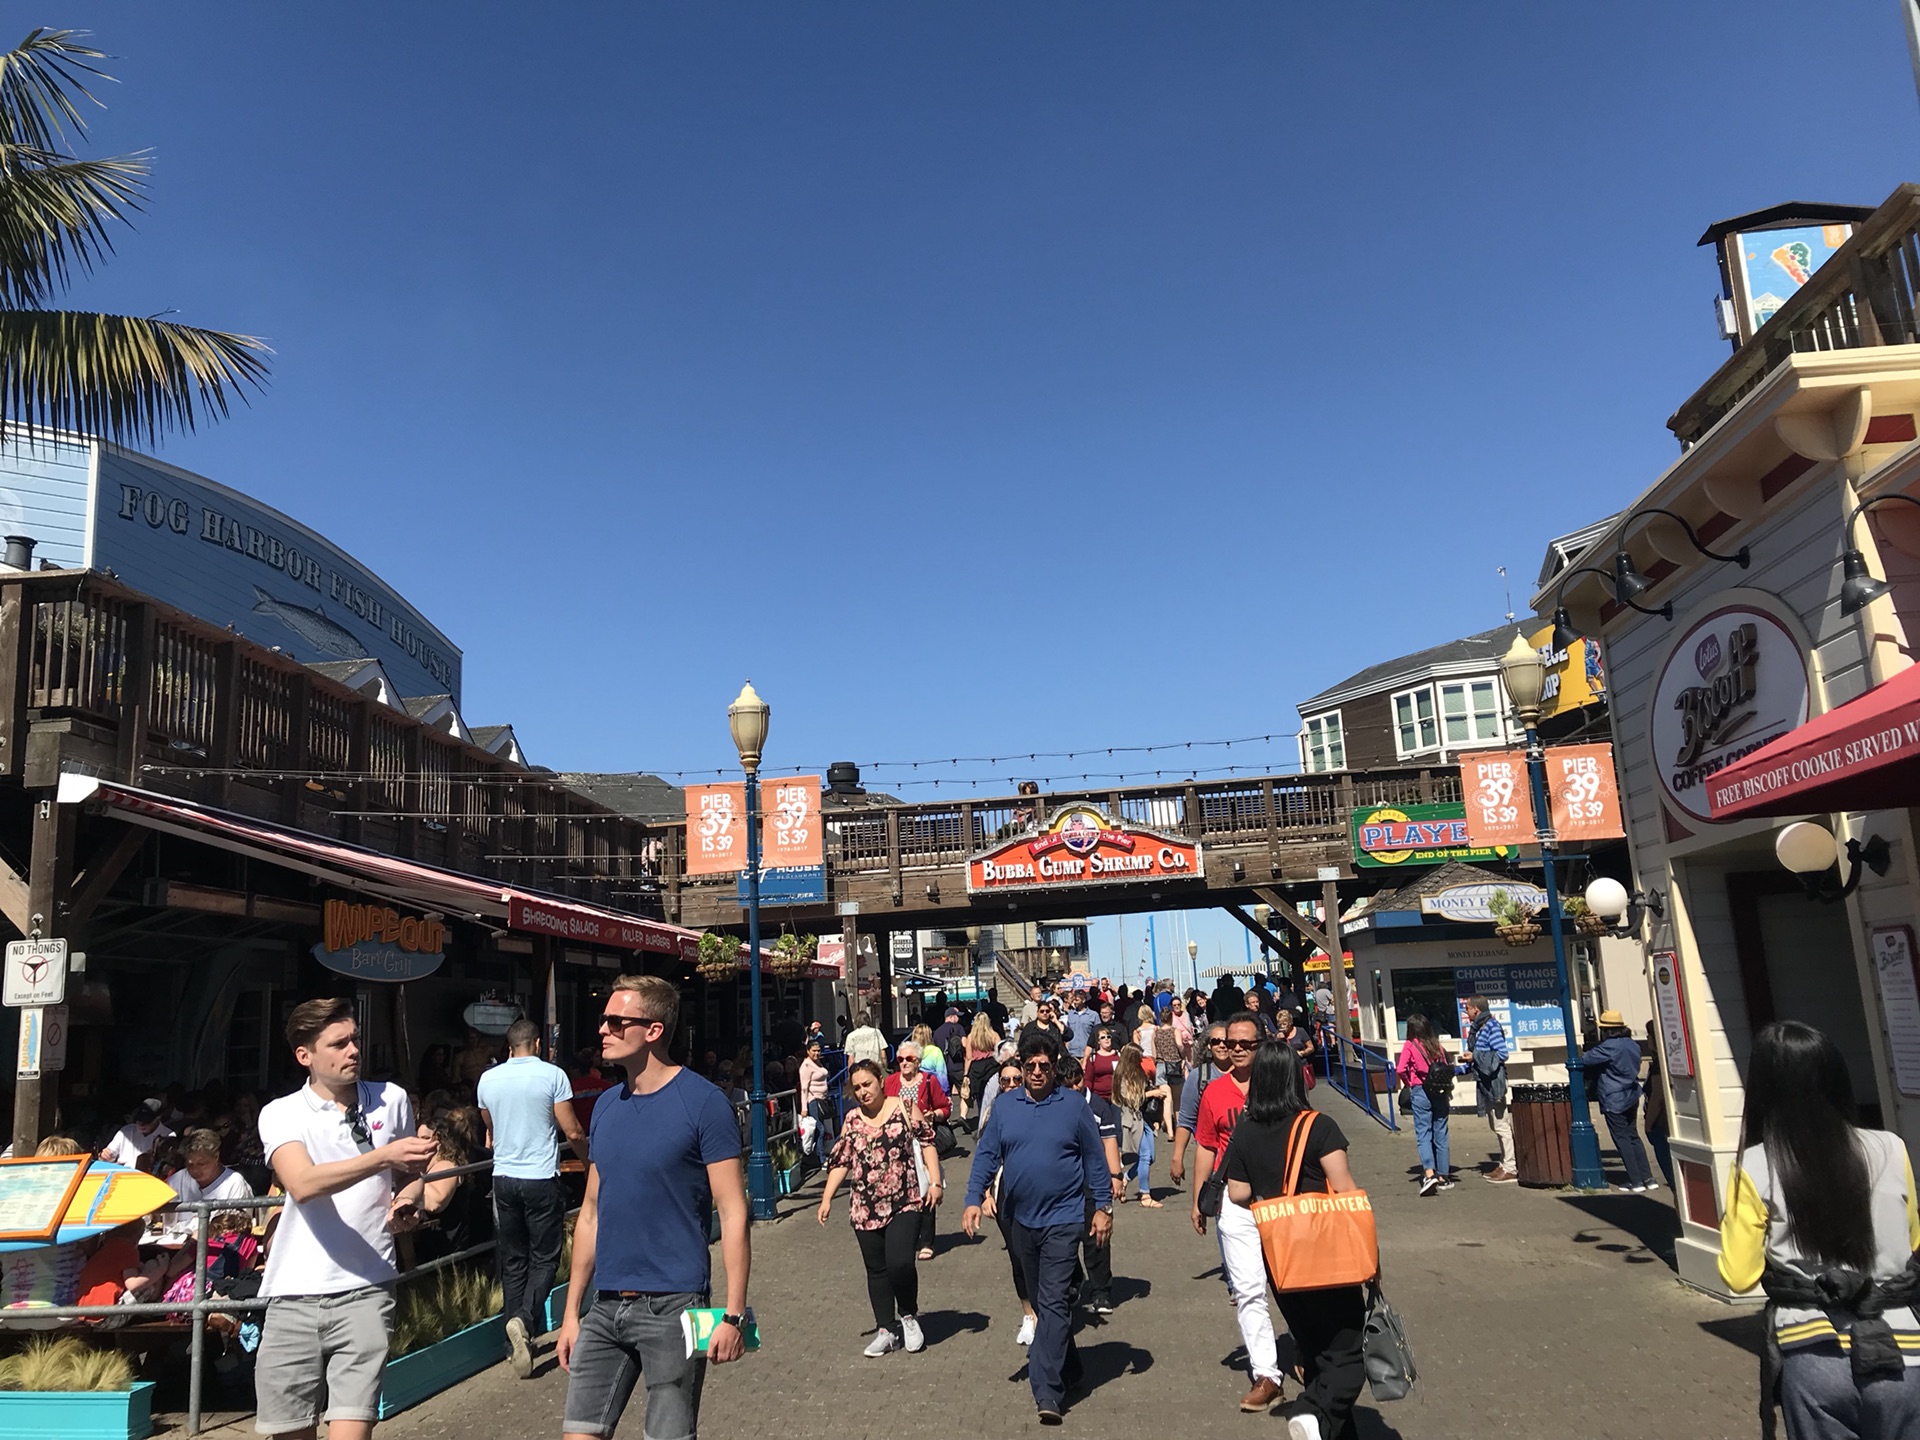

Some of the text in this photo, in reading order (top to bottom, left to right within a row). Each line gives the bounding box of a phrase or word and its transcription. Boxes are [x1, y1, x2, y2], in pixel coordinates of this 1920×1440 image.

[119, 484, 452, 691] FOG HARBOR FISH HOUSE
[1699, 641, 1719, 671] Lotus
[1674, 623, 1760, 767] Biscoff
[1477, 762, 1512, 779] PIER
[1563, 757, 1597, 774] PIER
[1715, 783, 1743, 808] FREE
[1742, 766, 1791, 799] BISCOFF
[1791, 748, 1844, 782] COOKIE
[1845, 728, 1902, 765] SERVED
[776, 787, 806, 803] PIER
[1479, 778, 1514, 807] 39
[1565, 772, 1600, 802] 39
[701, 793, 731, 809] PIER
[1568, 801, 1603, 818] IS 39
[701, 808, 732, 836] 39
[776, 801, 807, 830] 39
[1483, 806, 1518, 824] IS 39
[777, 829, 808, 845] IS 39
[1034, 839, 1048, 850] End
[1116, 834, 1131, 846] Pier
[1363, 821, 1469, 847] PLAYE
[702, 835, 733, 852] IS 39
[1415, 851, 1434, 859] END
[1470, 848, 1492, 856] PIER
[982, 860, 1036, 881] BUBBA
[1039, 855, 1085, 876] GUMP
[1089, 853, 1153, 873] SHRIMP
[1430, 898, 1475, 909] MONEY
[323, 898, 446, 953] WIPEOUT
[522, 907, 671, 949] SHREDDING SALADS KILLER BURGERS
[13, 943, 61, 955] NO THONGS
[1447, 949, 1511, 958] MONEY EXCHANGE
[352, 948, 375, 969] Bar
[384, 950, 411, 975] Grill
[1456, 968, 1505, 979] CHANGE
[1510, 968, 1557, 979] CHANGE
[1476, 982, 1499, 991] EURO
[1515, 979, 1555, 989] MONEY
[1515, 999, 1559, 1010] CAMBIO
[1517, 1020, 1538, 1032] 货币
[1253, 1201, 1295, 1224] URBAN
